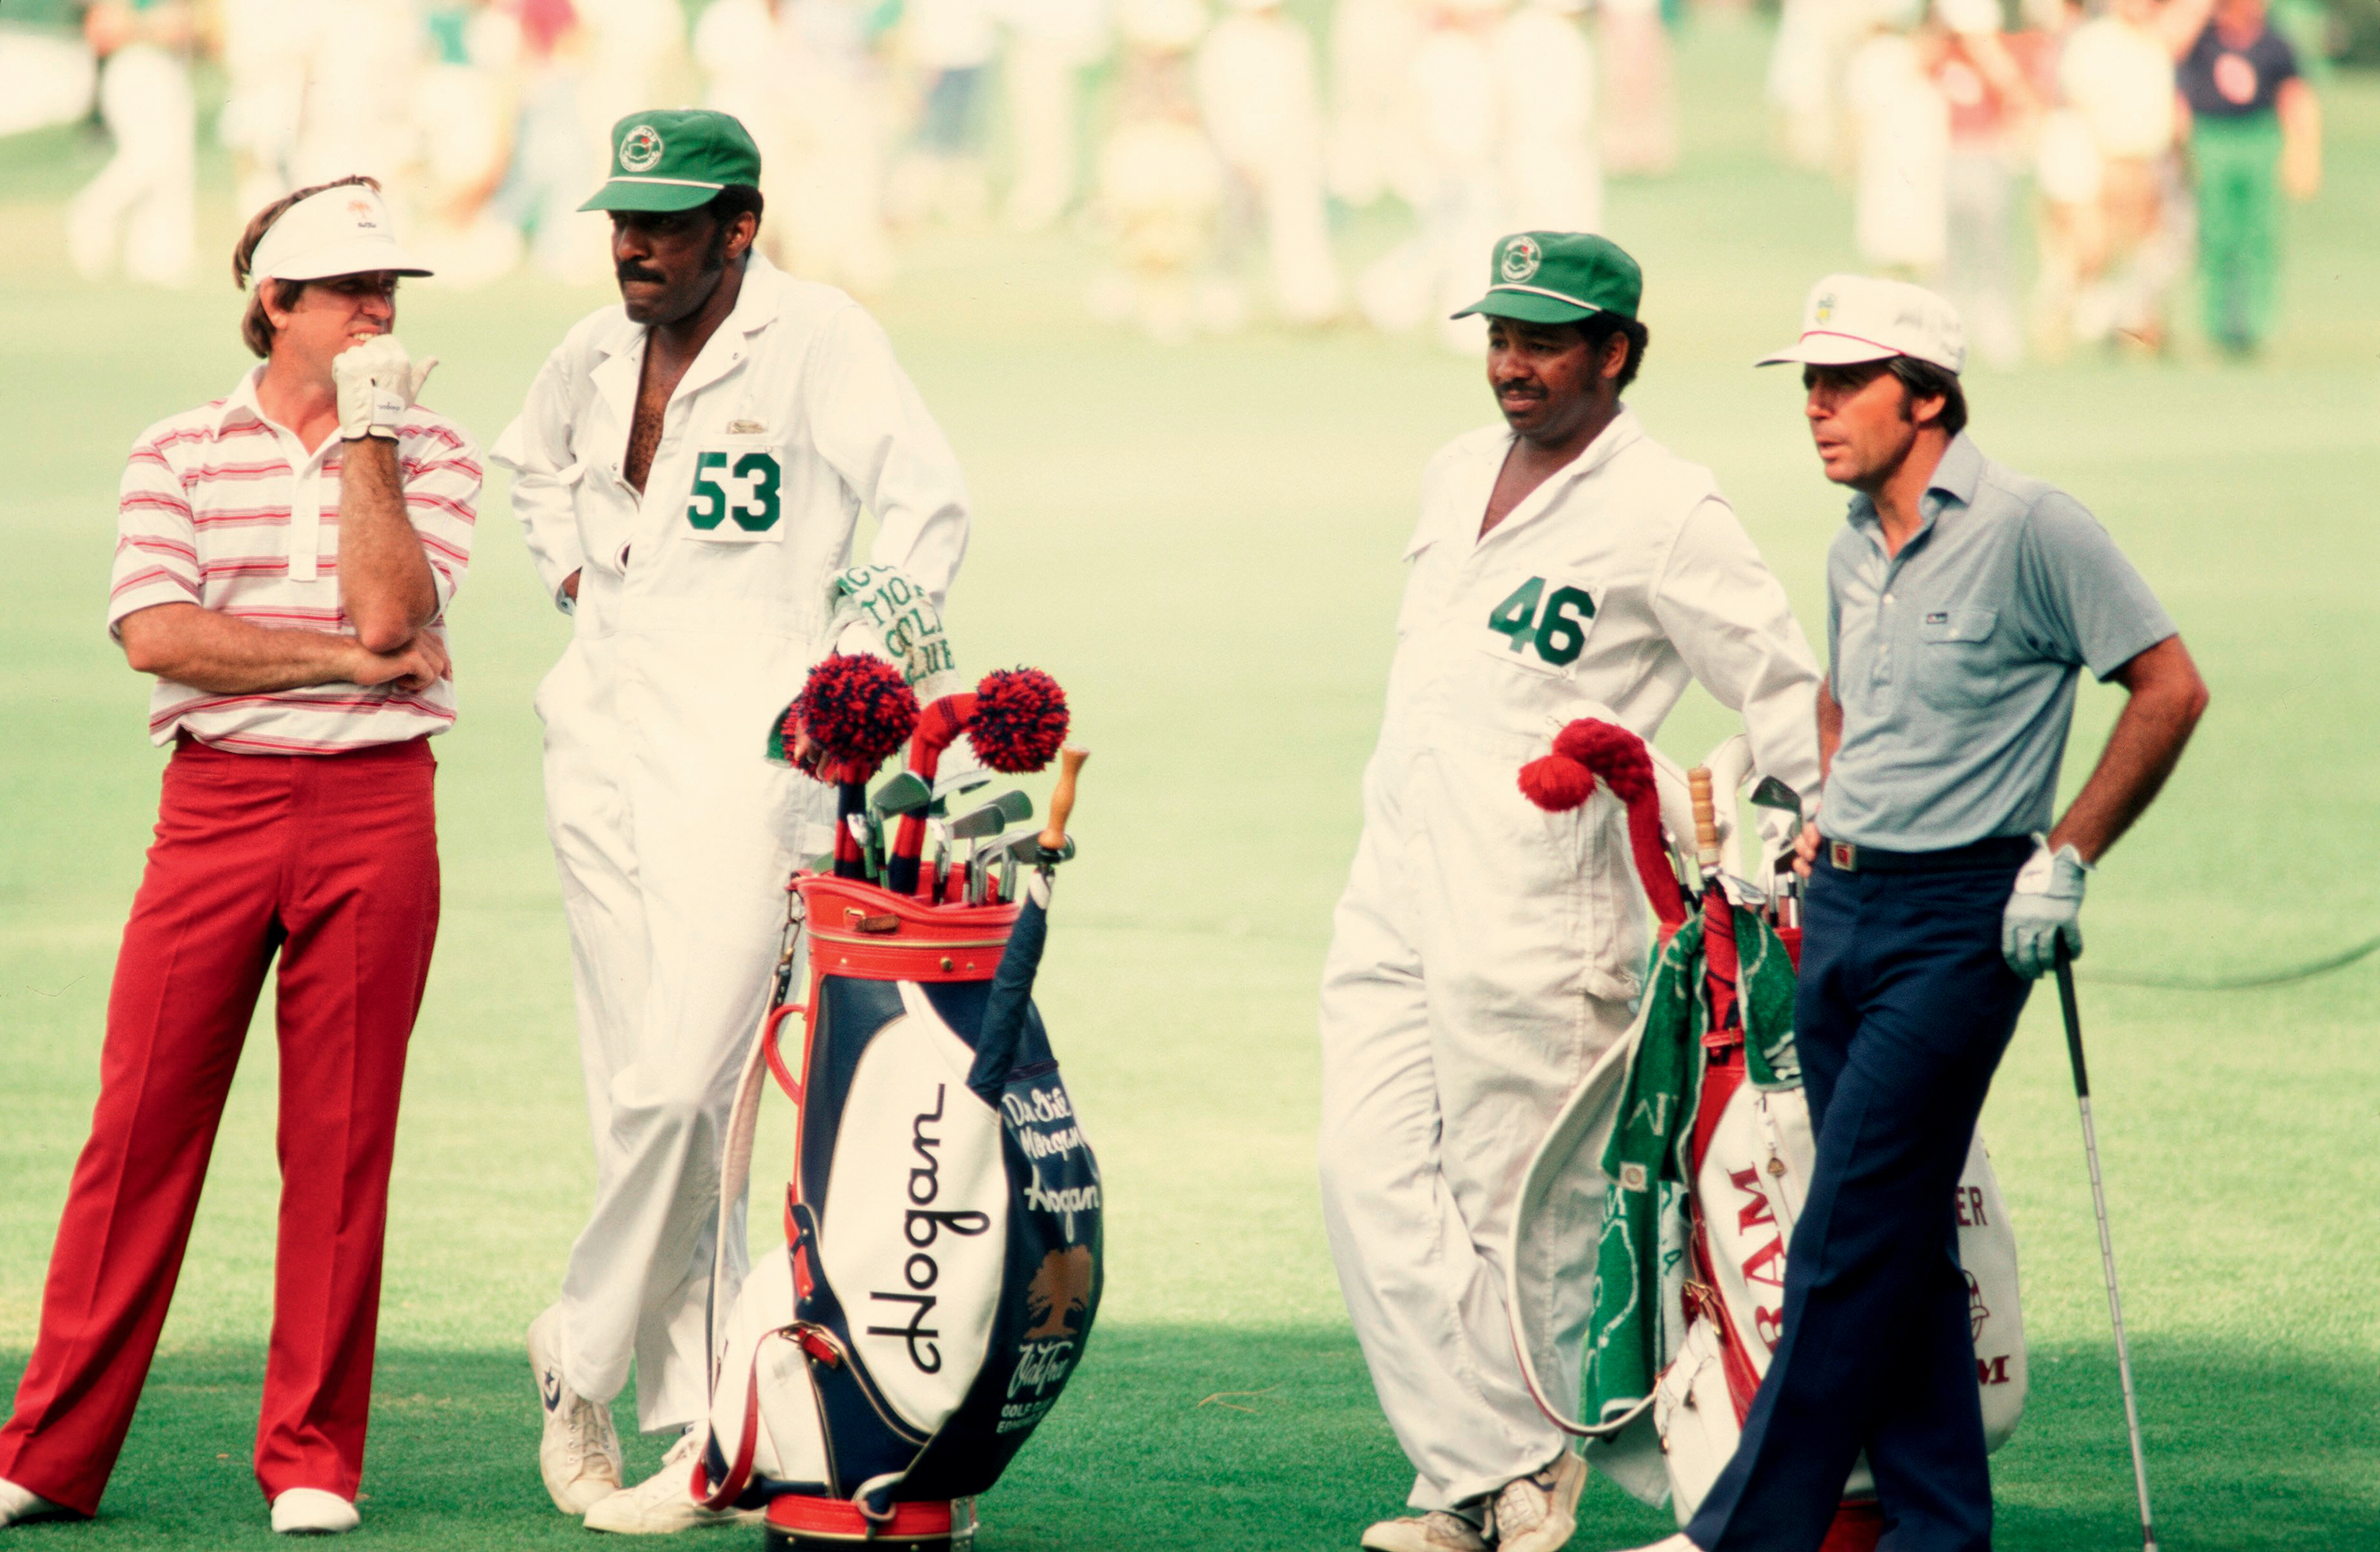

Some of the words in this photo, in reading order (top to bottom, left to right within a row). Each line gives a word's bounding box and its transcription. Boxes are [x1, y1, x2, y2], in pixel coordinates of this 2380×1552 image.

[686, 451, 781, 532] 53
[1487, 575, 1597, 667] 46
[1020, 1125, 1082, 1162] Morgan
[866, 1082, 991, 1375] Hogan
[1726, 1161, 1787, 1354] RAM
